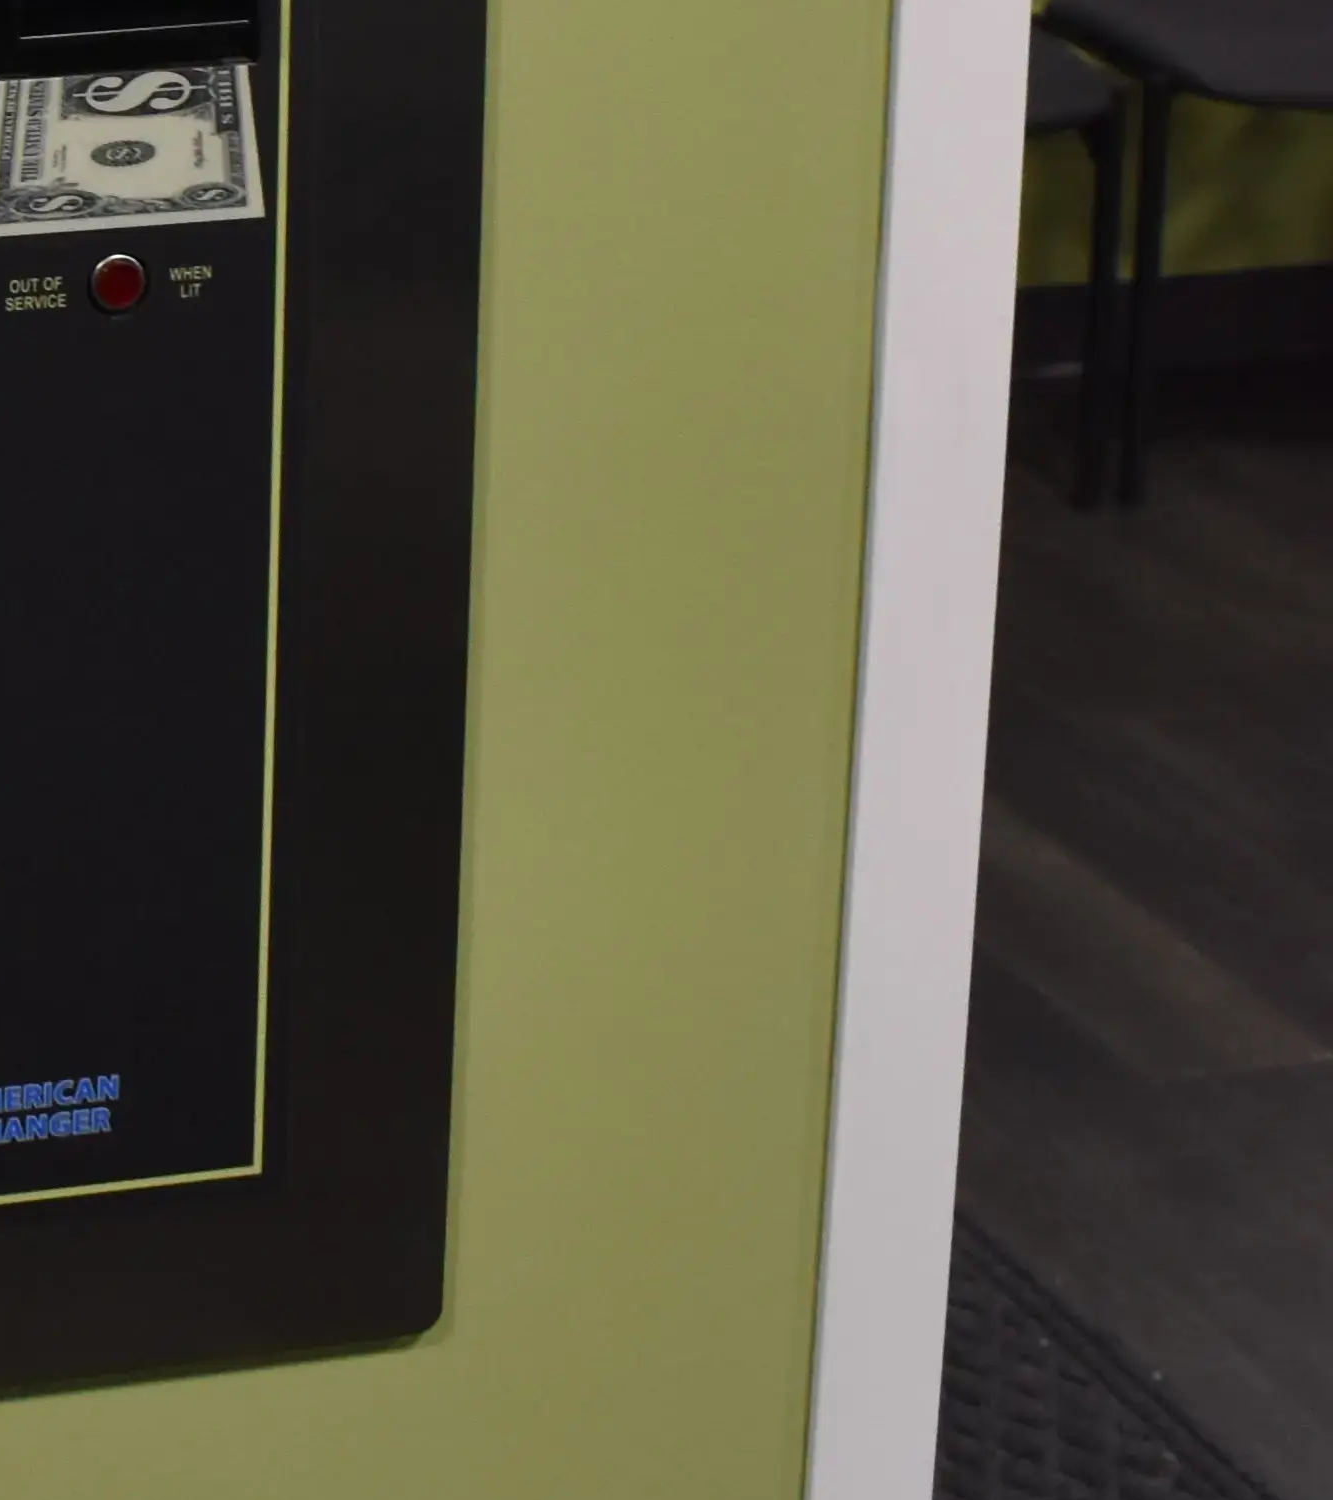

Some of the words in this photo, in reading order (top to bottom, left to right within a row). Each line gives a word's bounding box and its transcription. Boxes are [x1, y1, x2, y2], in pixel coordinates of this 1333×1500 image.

[169, 265, 213, 282] WHEN
[8, 278, 40, 294] OUT
[42, 276, 64, 291] OF
[180, 283, 202, 299] LIT
[5, 294, 67, 312] SERVICE
